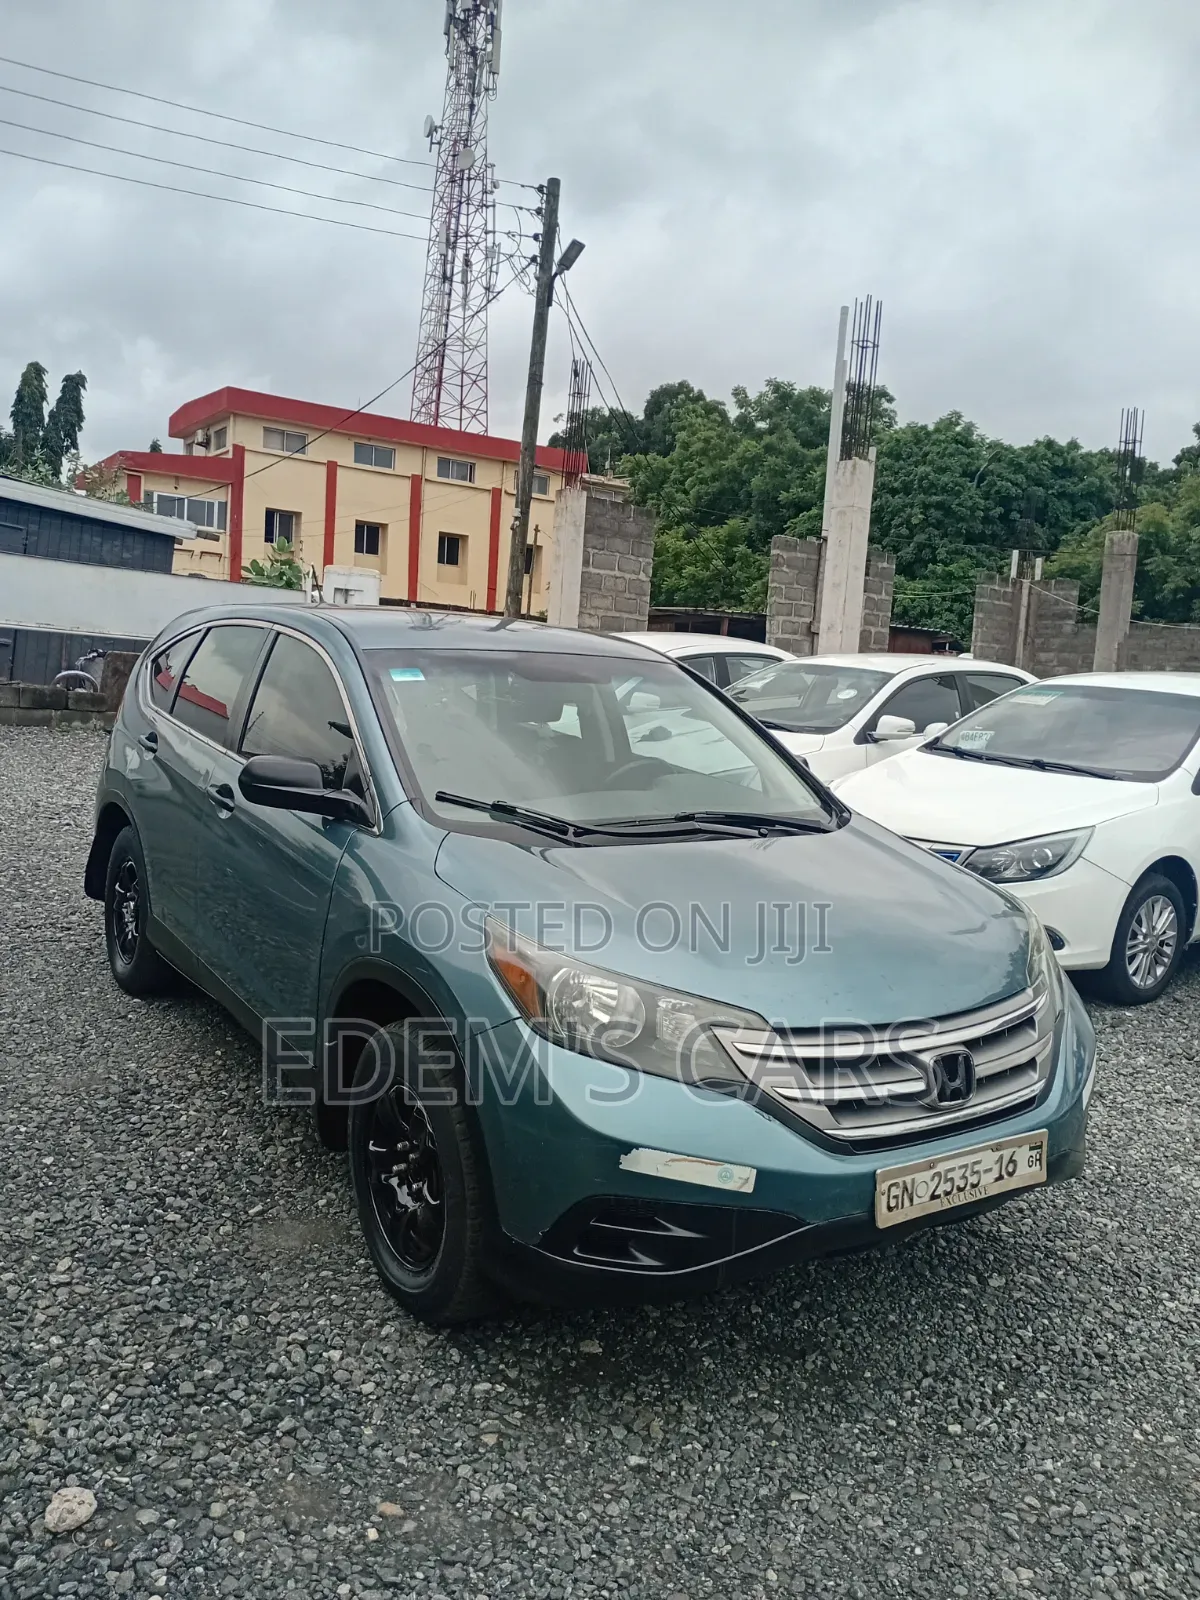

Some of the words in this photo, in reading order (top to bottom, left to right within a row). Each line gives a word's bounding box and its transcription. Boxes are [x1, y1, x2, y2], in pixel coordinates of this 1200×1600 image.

[886, 1178, 915, 1212] GN
[929, 1151, 1018, 1200] 2535-16
[940, 1186, 989, 1208] EXCLUSIVE
